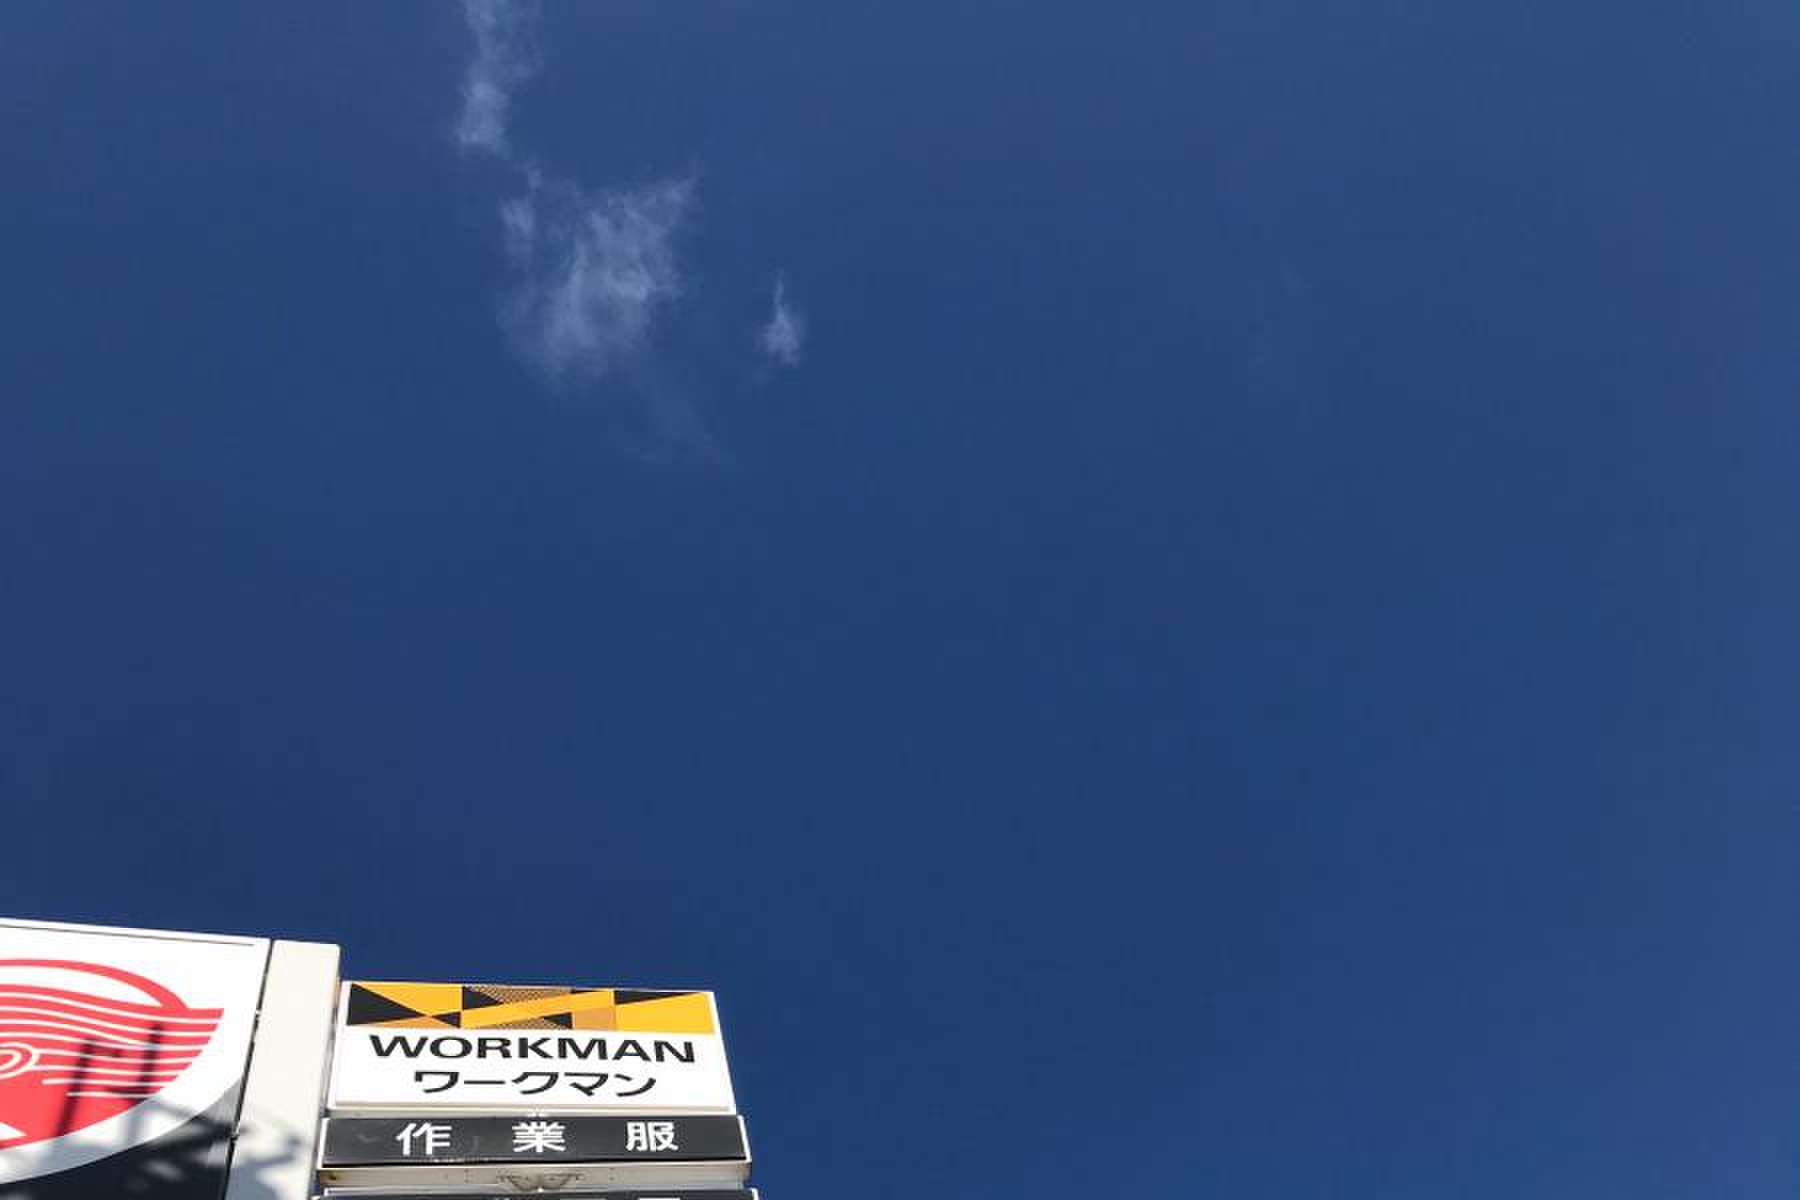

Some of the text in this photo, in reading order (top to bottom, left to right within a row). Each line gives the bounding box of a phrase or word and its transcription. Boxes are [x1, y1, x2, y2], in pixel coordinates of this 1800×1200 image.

[369, 1034, 696, 1064] WORKMAN
[413, 1070, 657, 1097] ワークマン
[396, 1120, 680, 1156] 作業服
